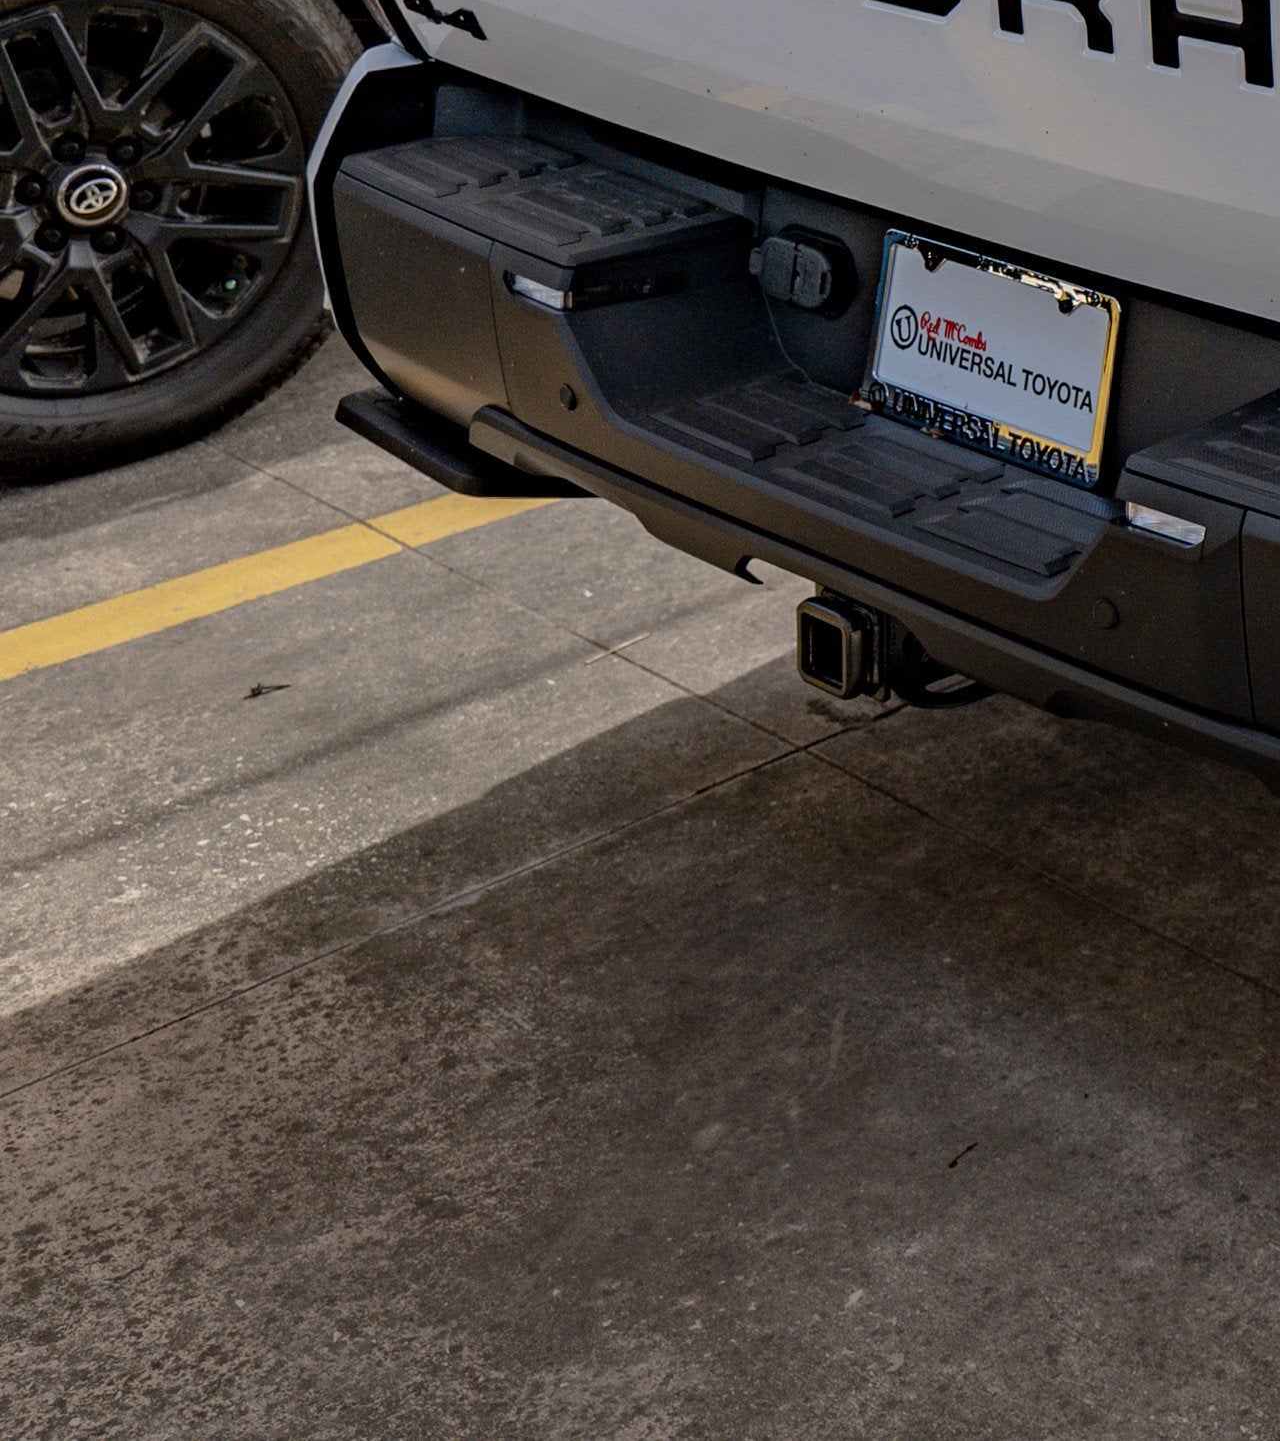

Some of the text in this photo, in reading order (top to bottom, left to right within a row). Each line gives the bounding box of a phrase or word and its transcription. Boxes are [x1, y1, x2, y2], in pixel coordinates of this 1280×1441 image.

[920, 311, 987, 352] Red McCombs
[917, 334, 1093, 413] UNIVERSAL TOYOTA
[893, 390, 1006, 451] UNIVERSAL
[1008, 431, 1091, 483] TOYOTA
